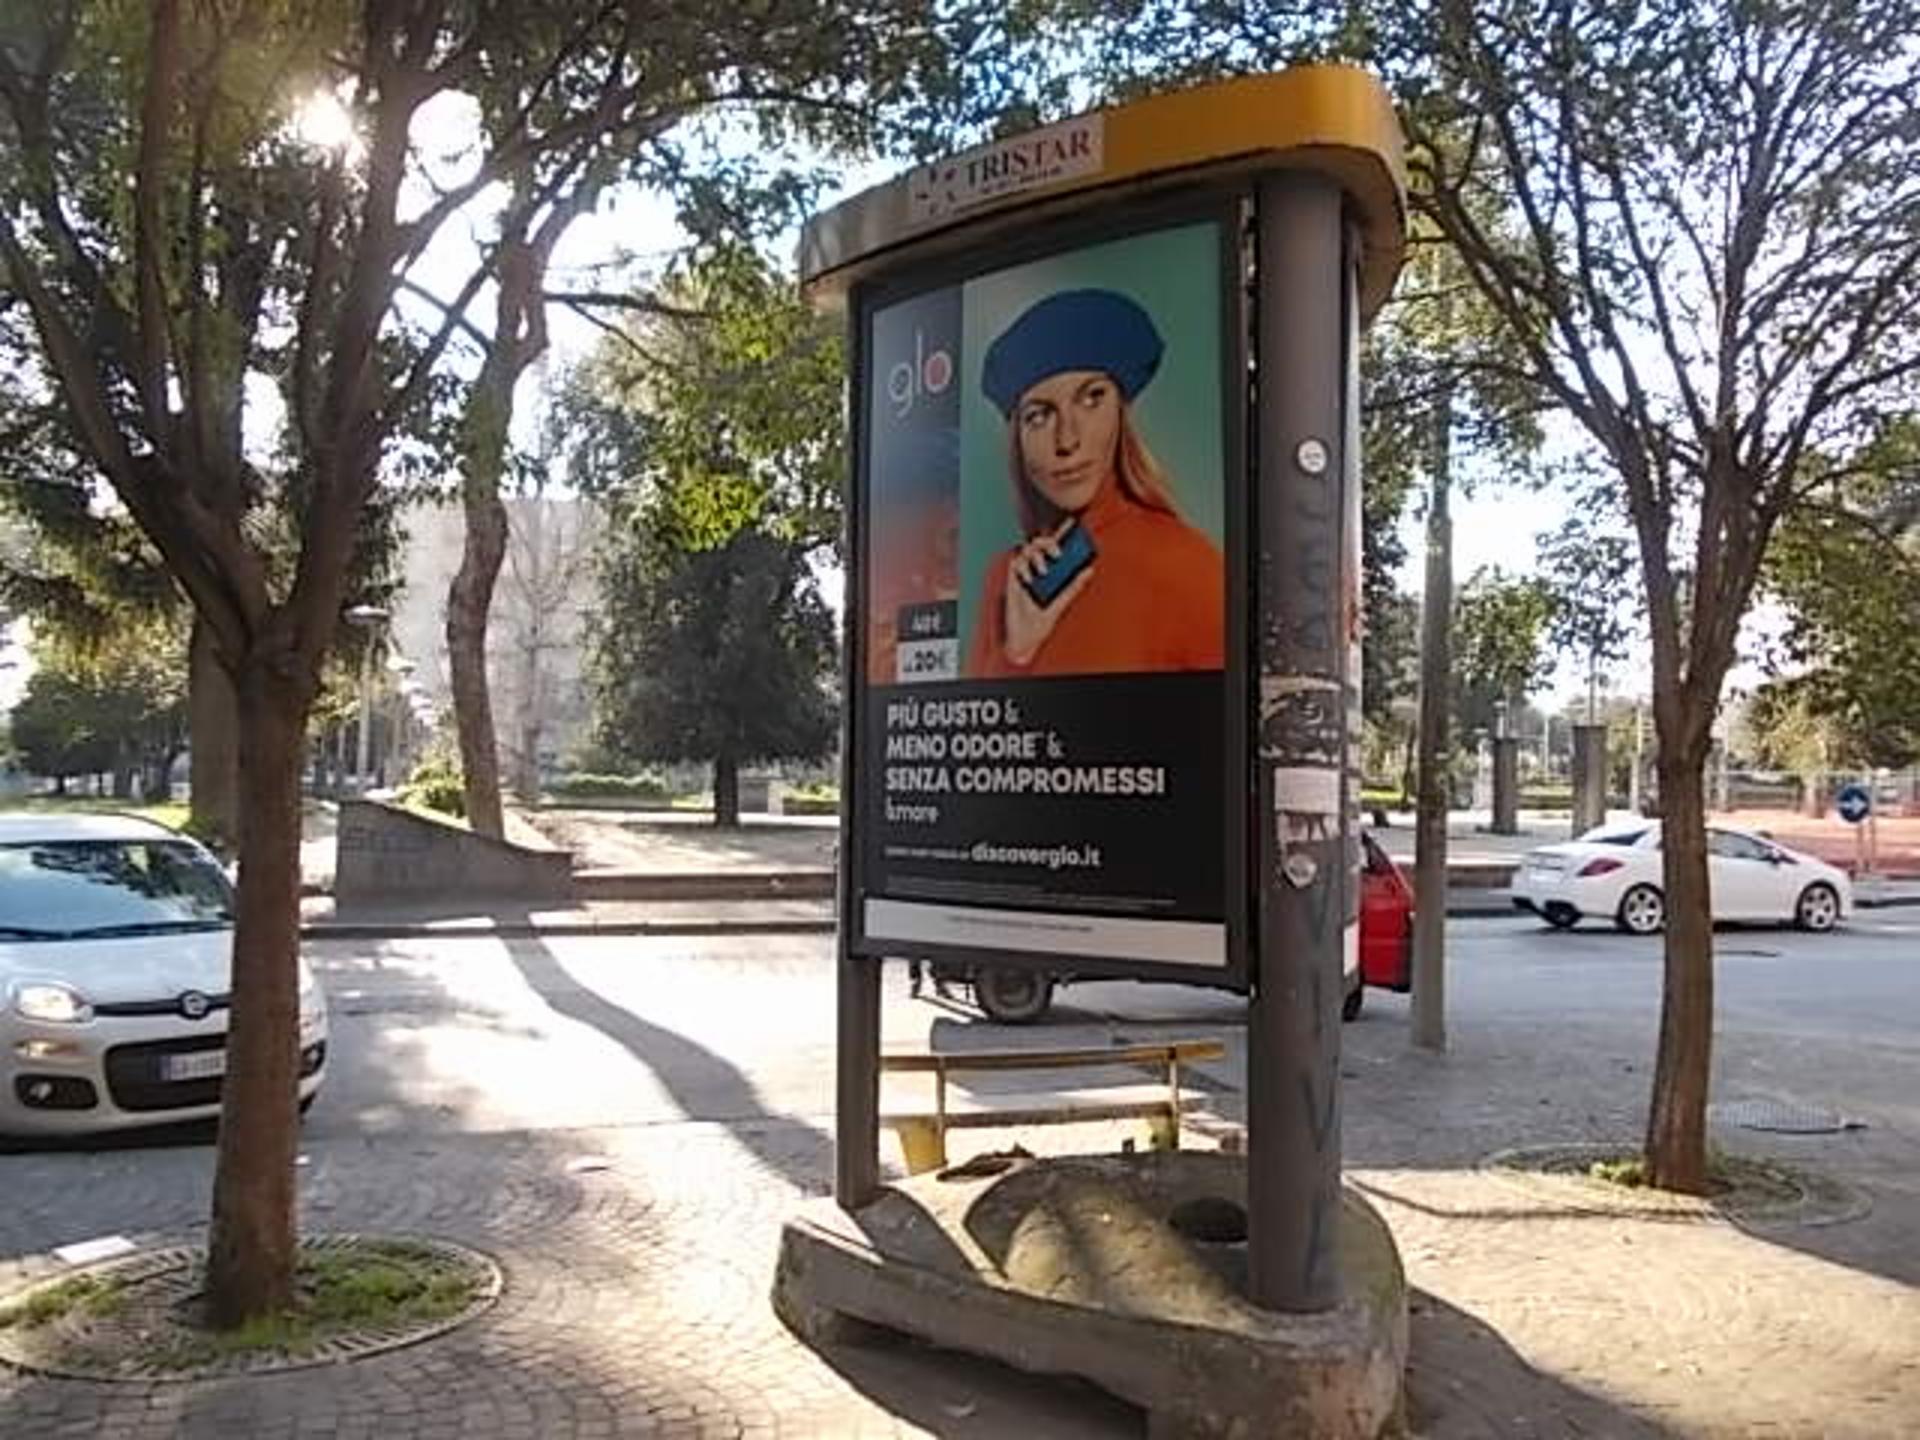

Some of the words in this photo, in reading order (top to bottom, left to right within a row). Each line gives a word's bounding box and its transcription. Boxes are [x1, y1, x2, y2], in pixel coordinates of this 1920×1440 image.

[966, 128, 1092, 189] TRISTAR
[888, 328, 952, 420] glo
[886, 698, 919, 726] PIÙ
[922, 700, 1000, 726] GUSTO
[886, 734, 946, 759] MENO
[885, 767, 951, 792] SENZA
[955, 766, 1165, 793] COMPROMESSI
[971, 844, 1102, 868] discoverglo.it
